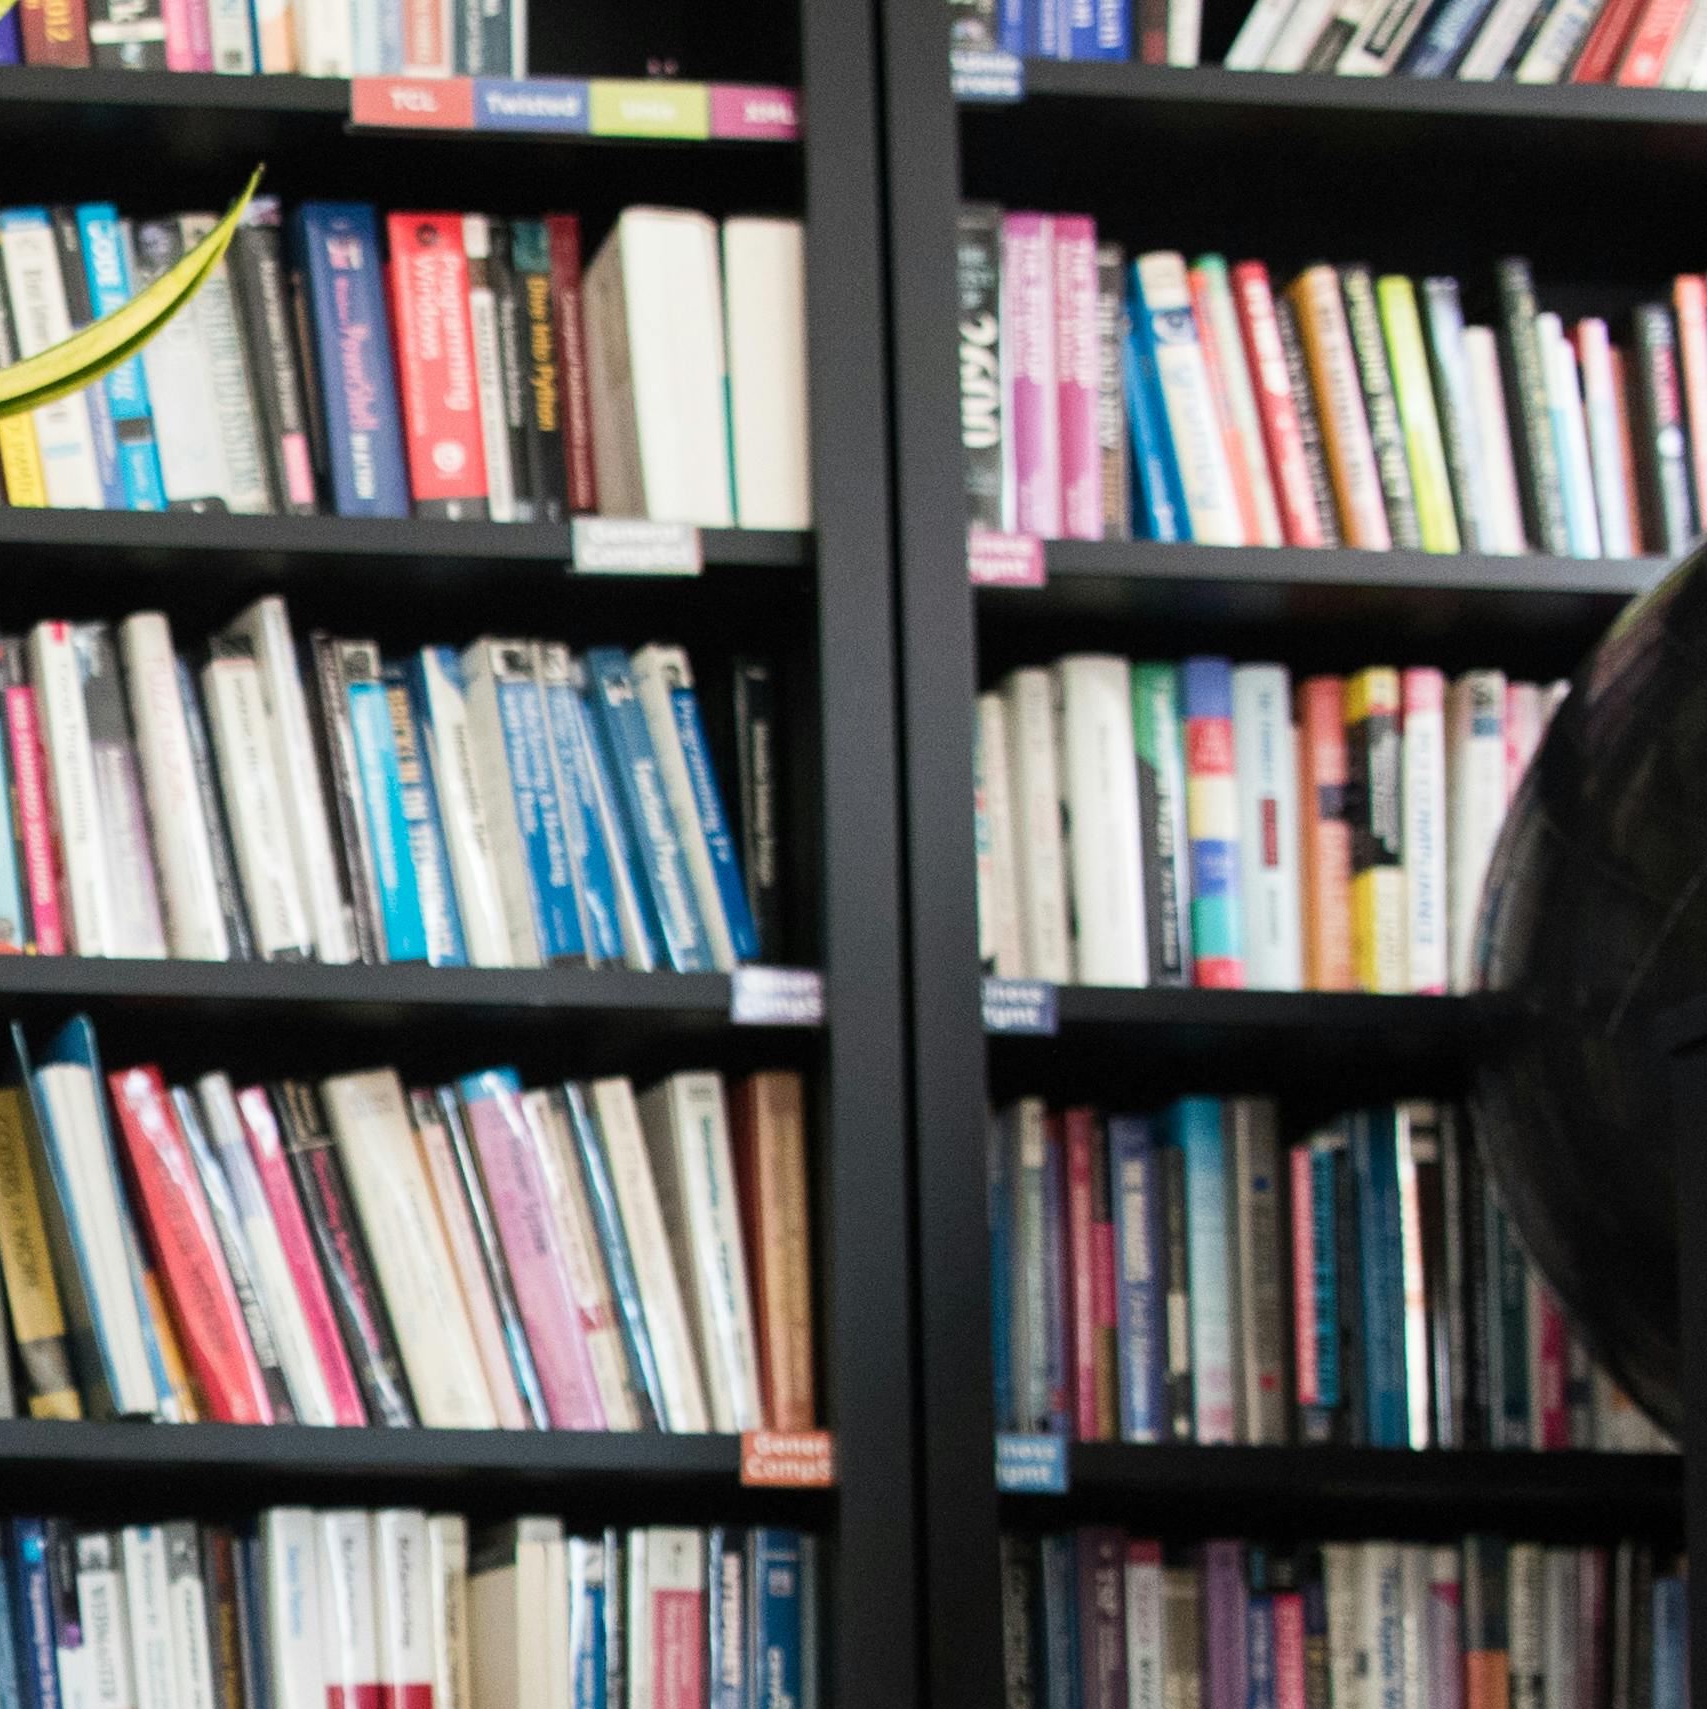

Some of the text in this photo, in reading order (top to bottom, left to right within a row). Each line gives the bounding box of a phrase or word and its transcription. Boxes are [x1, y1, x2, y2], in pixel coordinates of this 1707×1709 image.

[390, 89, 438, 114] TCL
[485, 91, 581, 119] Twisted
[413, 254, 444, 361] Windows
[438, 252, 475, 413] Programming
[528, 276, 558, 432] Dive Python
[340, 323, 380, 430] PowerShell
